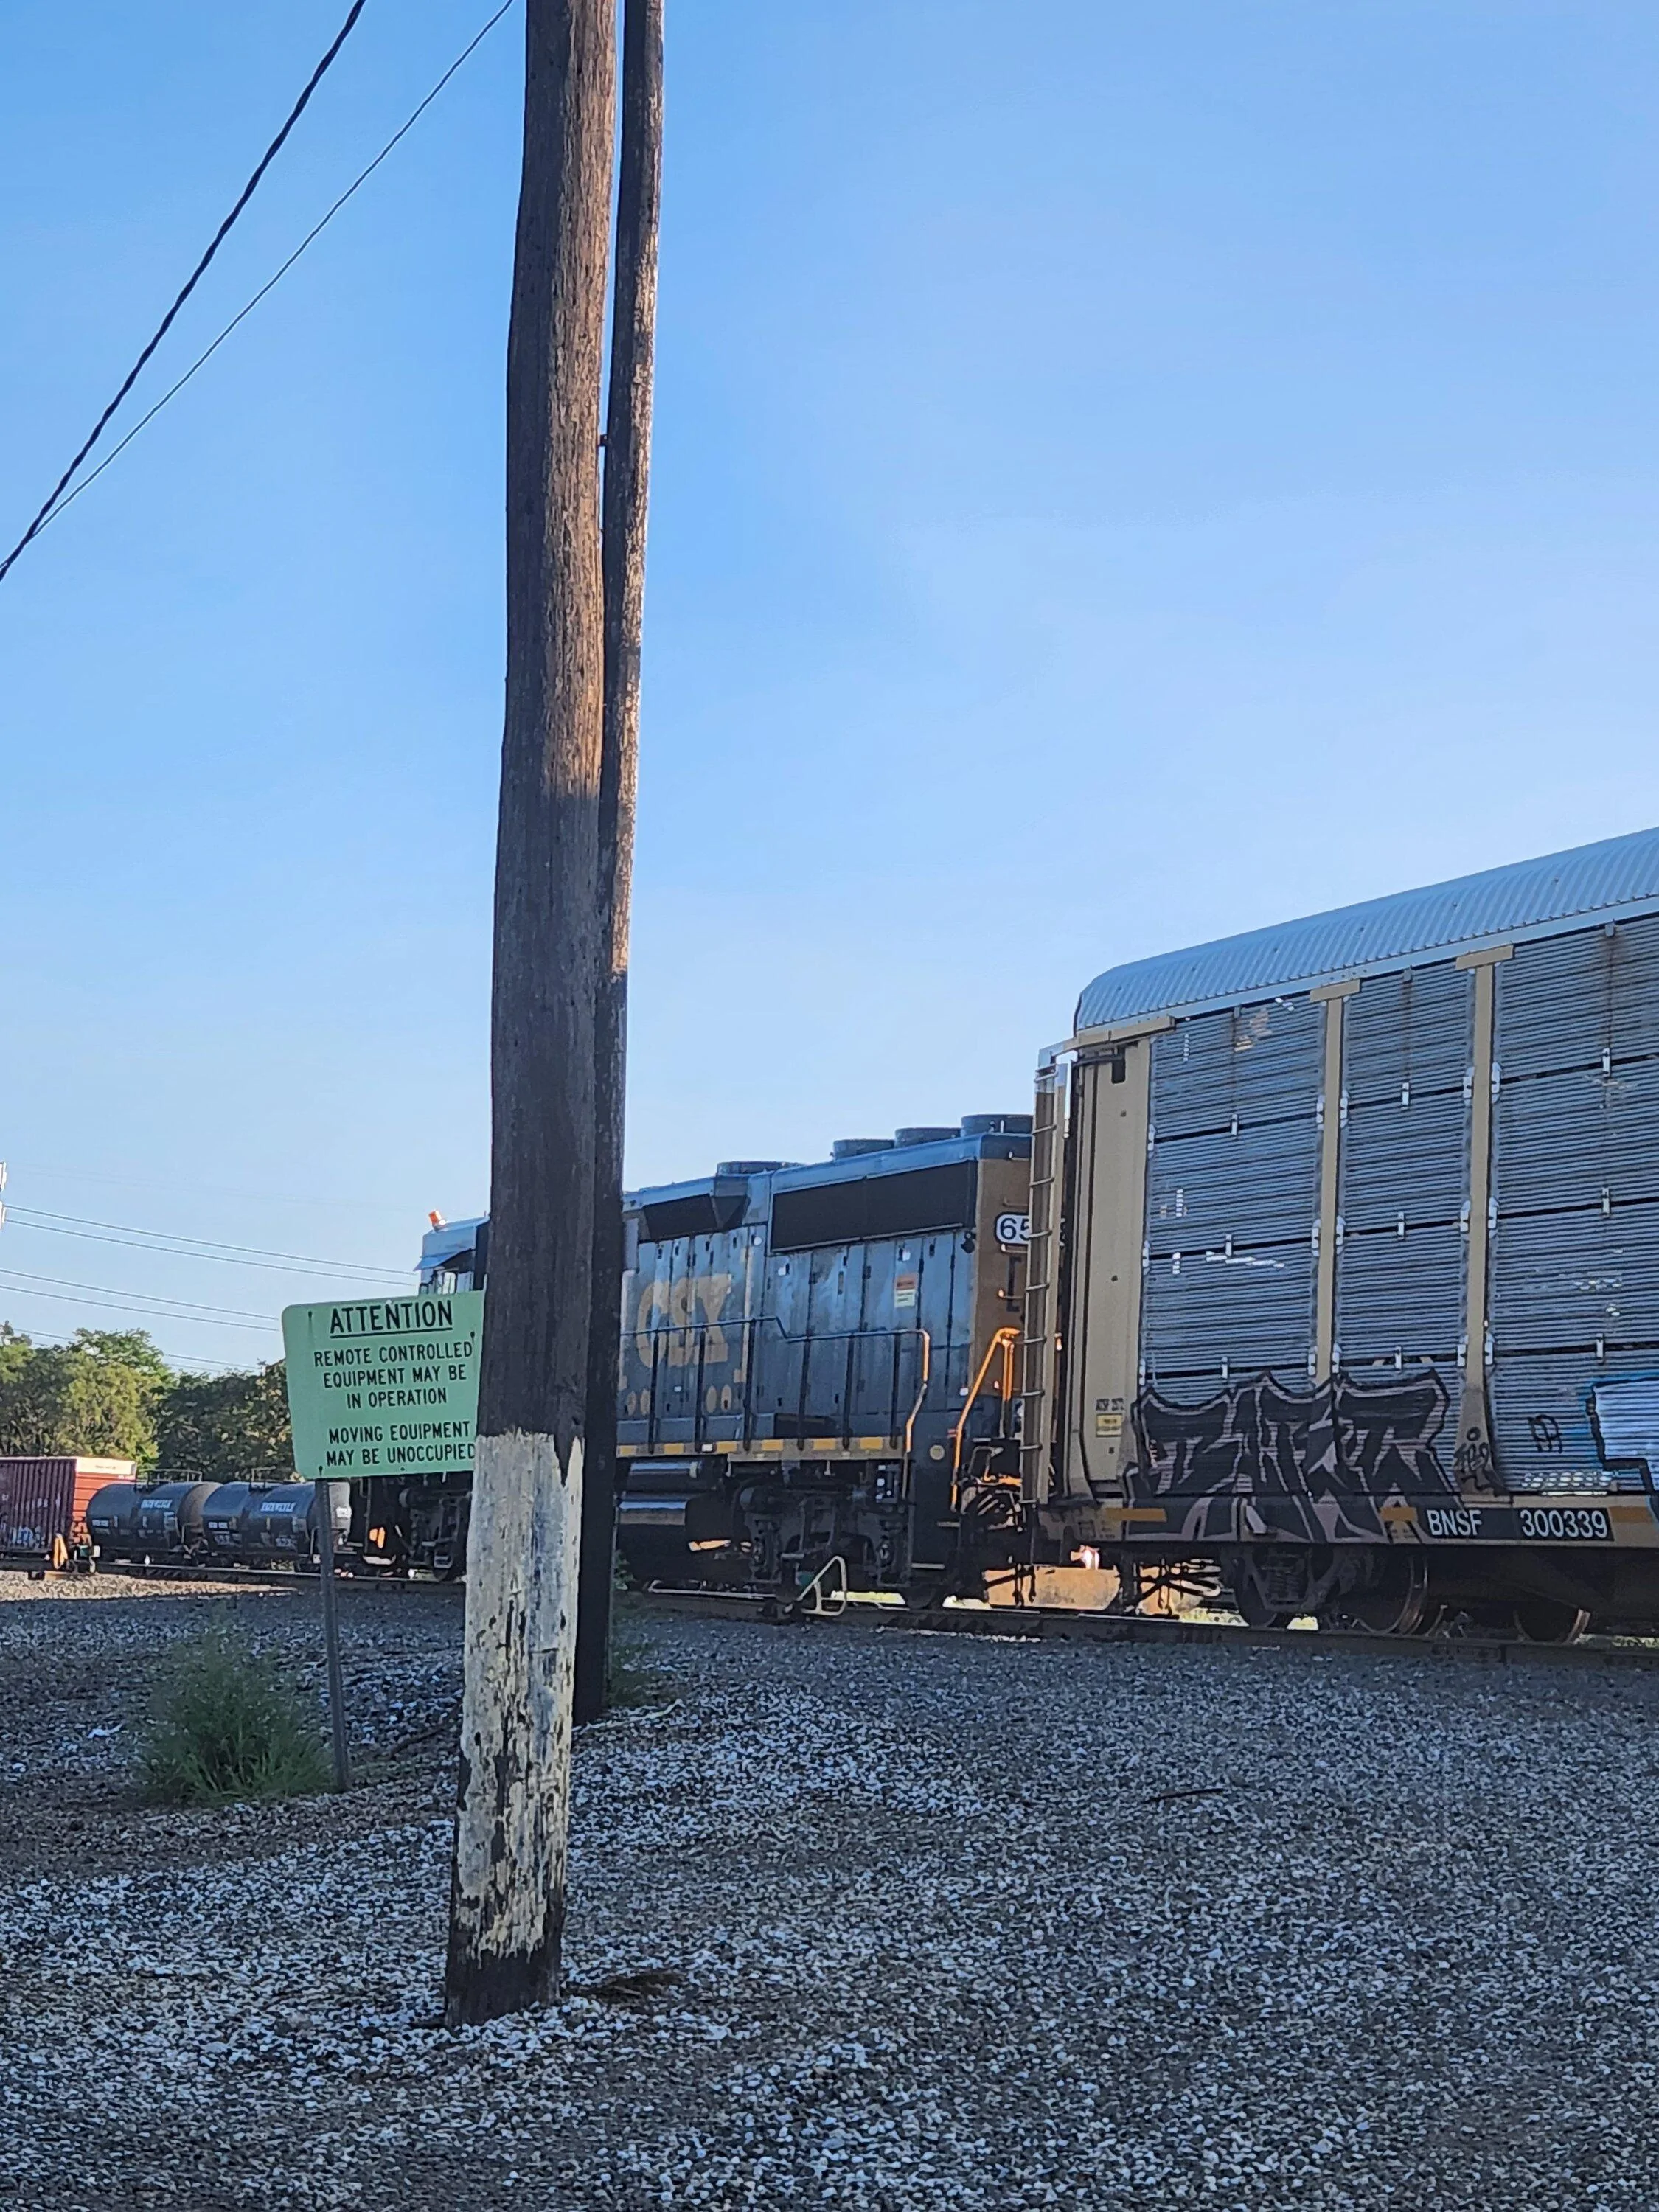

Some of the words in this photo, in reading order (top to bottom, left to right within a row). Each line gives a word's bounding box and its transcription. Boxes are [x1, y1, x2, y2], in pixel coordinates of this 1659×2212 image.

[1000, 1217, 1031, 1242] 65
[330, 1300, 453, 1334] ATTENTION
[636, 1274, 732, 1368] CSX
[314, 1347, 372, 1367] REMOTE
[379, 1341, 473, 1363] CONTROLLED
[324, 1368, 405, 1388] EQUIPMENT
[413, 1366, 441, 1383] MAY
[448, 1364, 467, 1380] BE
[347, 1393, 361, 1409] IN
[369, 1388, 447, 1408] OPERATION
[329, 1426, 383, 1444] MOVING
[390, 1421, 470, 1441] EQUIPMENT
[326, 1449, 355, 1467] MAY
[362, 1448, 380, 1464] BE
[387, 1443, 476, 1464] UNOCCUPIED
[1426, 1509, 1483, 1537] BNSF
[1520, 1509, 1607, 1539] 300339
